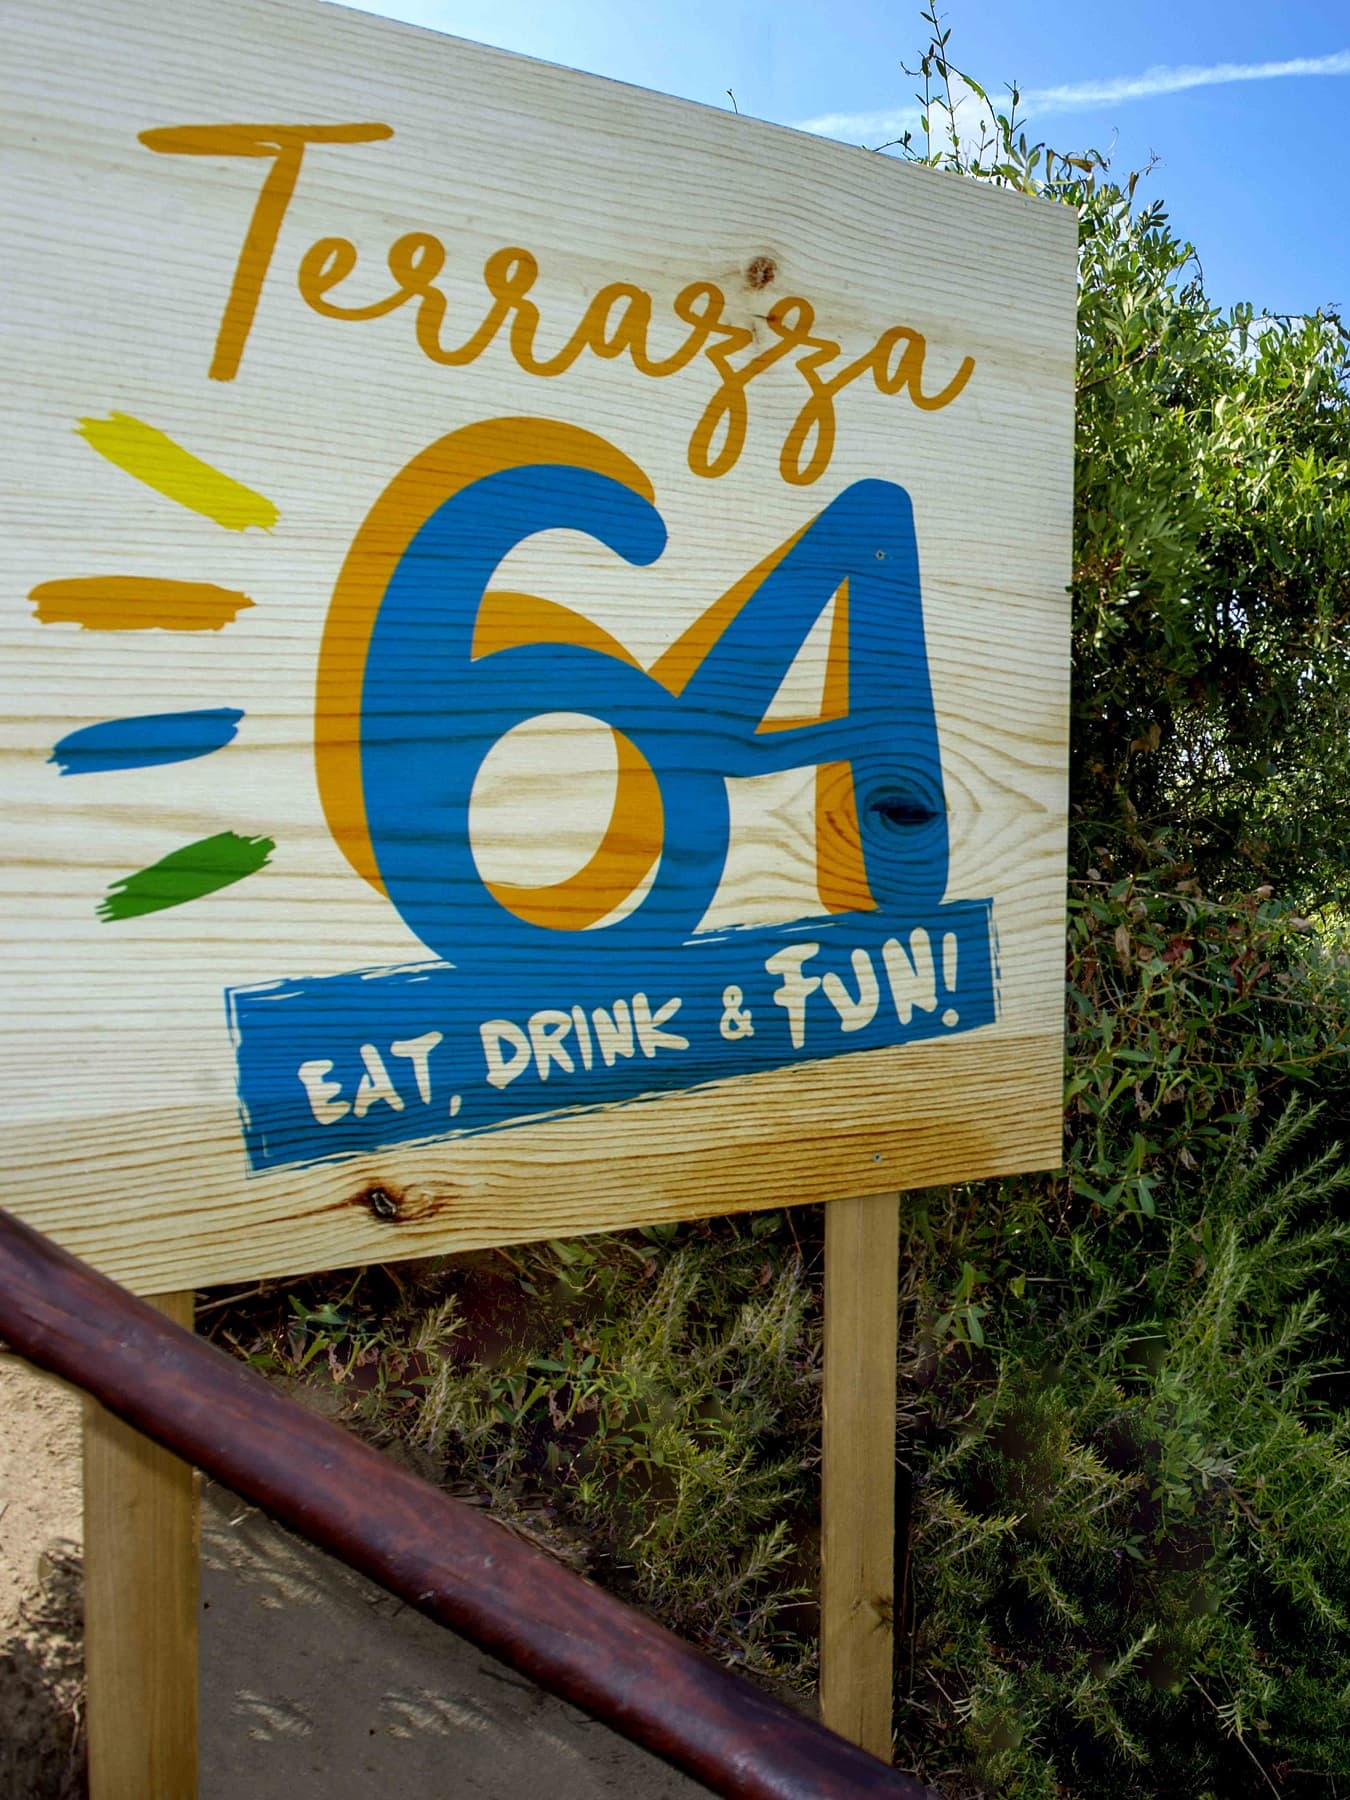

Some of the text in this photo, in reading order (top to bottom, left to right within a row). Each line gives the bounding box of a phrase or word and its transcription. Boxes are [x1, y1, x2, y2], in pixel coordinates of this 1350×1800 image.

[138, 123, 976, 486] Terrazza
[298, 927, 960, 1125] EAT, DRINK & FUN!
